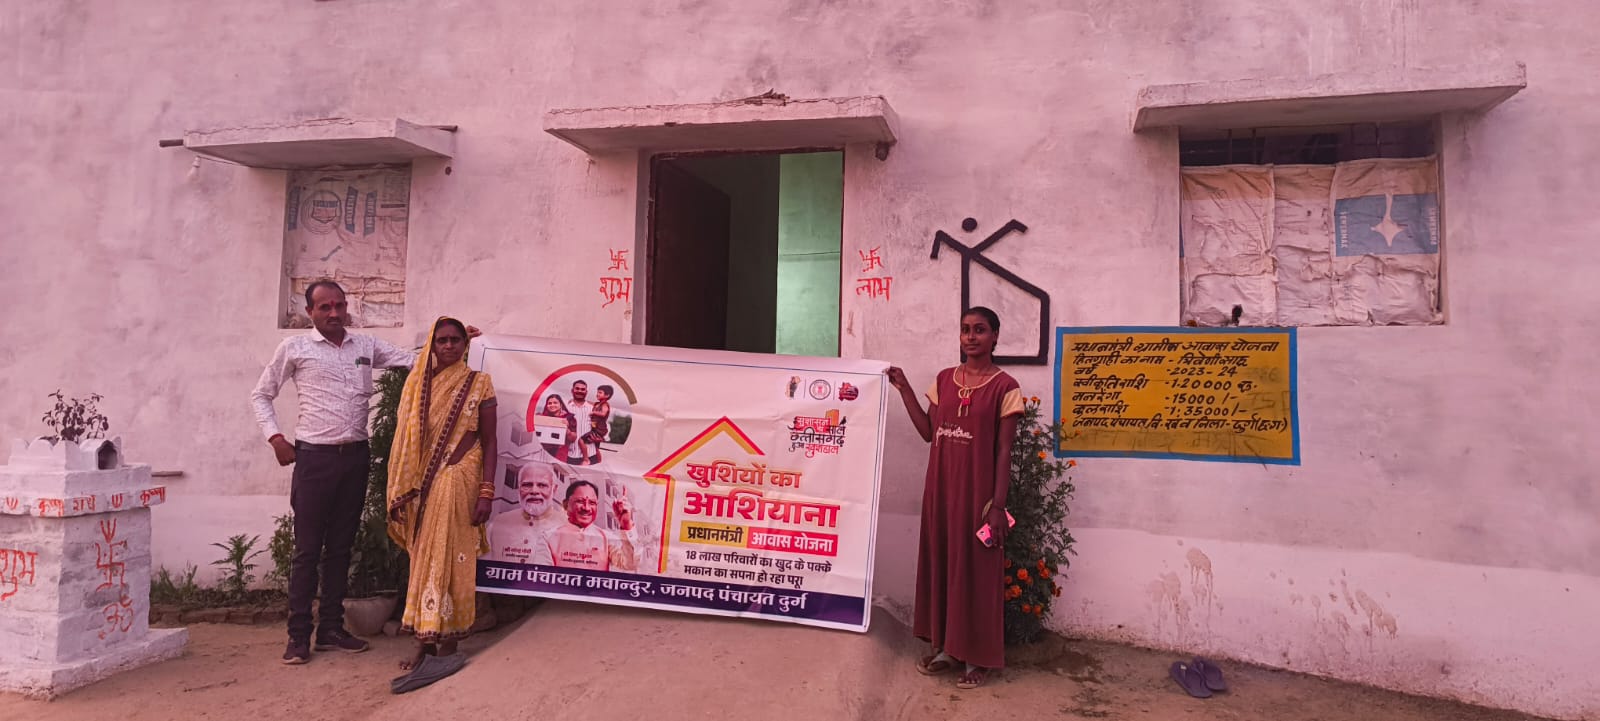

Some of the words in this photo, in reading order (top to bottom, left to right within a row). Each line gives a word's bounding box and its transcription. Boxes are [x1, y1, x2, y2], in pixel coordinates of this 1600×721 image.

[600, 277, 632, 308] शुभ
[856, 276, 892, 301] लाभ
[1231, 338, 1280, 352] योजना
[687, 460, 765, 488] खुशियों
[769, 469, 802, 489] का
[683, 489, 840, 528] आशियाना
[687, 525, 744, 543] प्रधानमंत्री
[751, 531, 792, 548] आवास
[794, 533, 834, 552] योजना
[684, 565, 712, 577] मकान
[714, 568, 728, 579] का
[730, 569, 755, 581] सपना
[757, 570, 767, 583] हो
[769, 574, 785, 585] रहा
[686, 550, 697, 560] 18
[700, 551, 721, 562] लाख
[724, 552, 758, 566] परिवारों
[760, 558, 773, 568] का
[775, 559, 792, 572] खुद
[794, 557, 805, 570] के
[807, 560, 832, 573] पक्के
[485, 566, 522, 582] ग्राम
[526, 566, 583, 587] पंचायत
[660, 583, 715, 601] जनपद
[718, 585, 775, 606] पंचायत
[779, 592, 808, 612] दुर्ग
